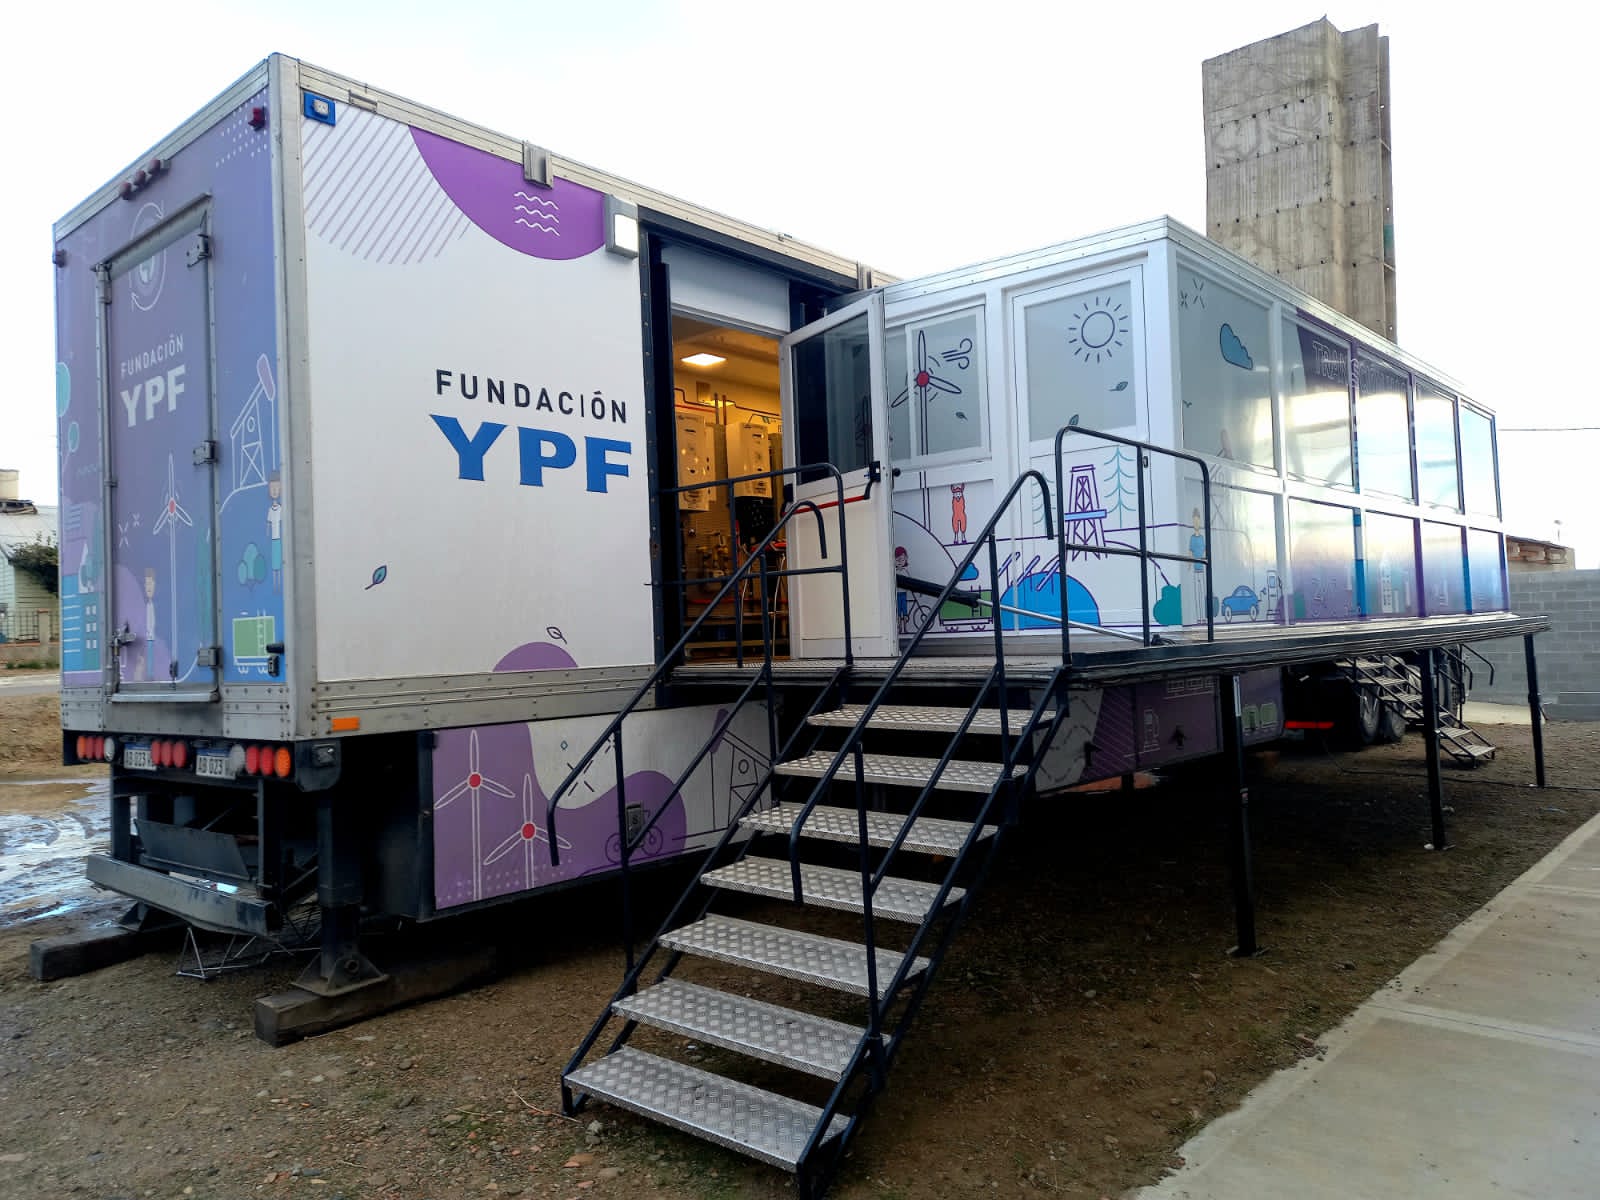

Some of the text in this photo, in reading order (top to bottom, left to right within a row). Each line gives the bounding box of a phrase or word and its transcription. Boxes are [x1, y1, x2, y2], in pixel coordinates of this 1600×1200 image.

[120, 333, 184, 380] FUNDACIÓN
[120, 362, 186, 428] YPF
[436, 368, 627, 424] FUNDACIÓN
[429, 414, 632, 493] YPF
